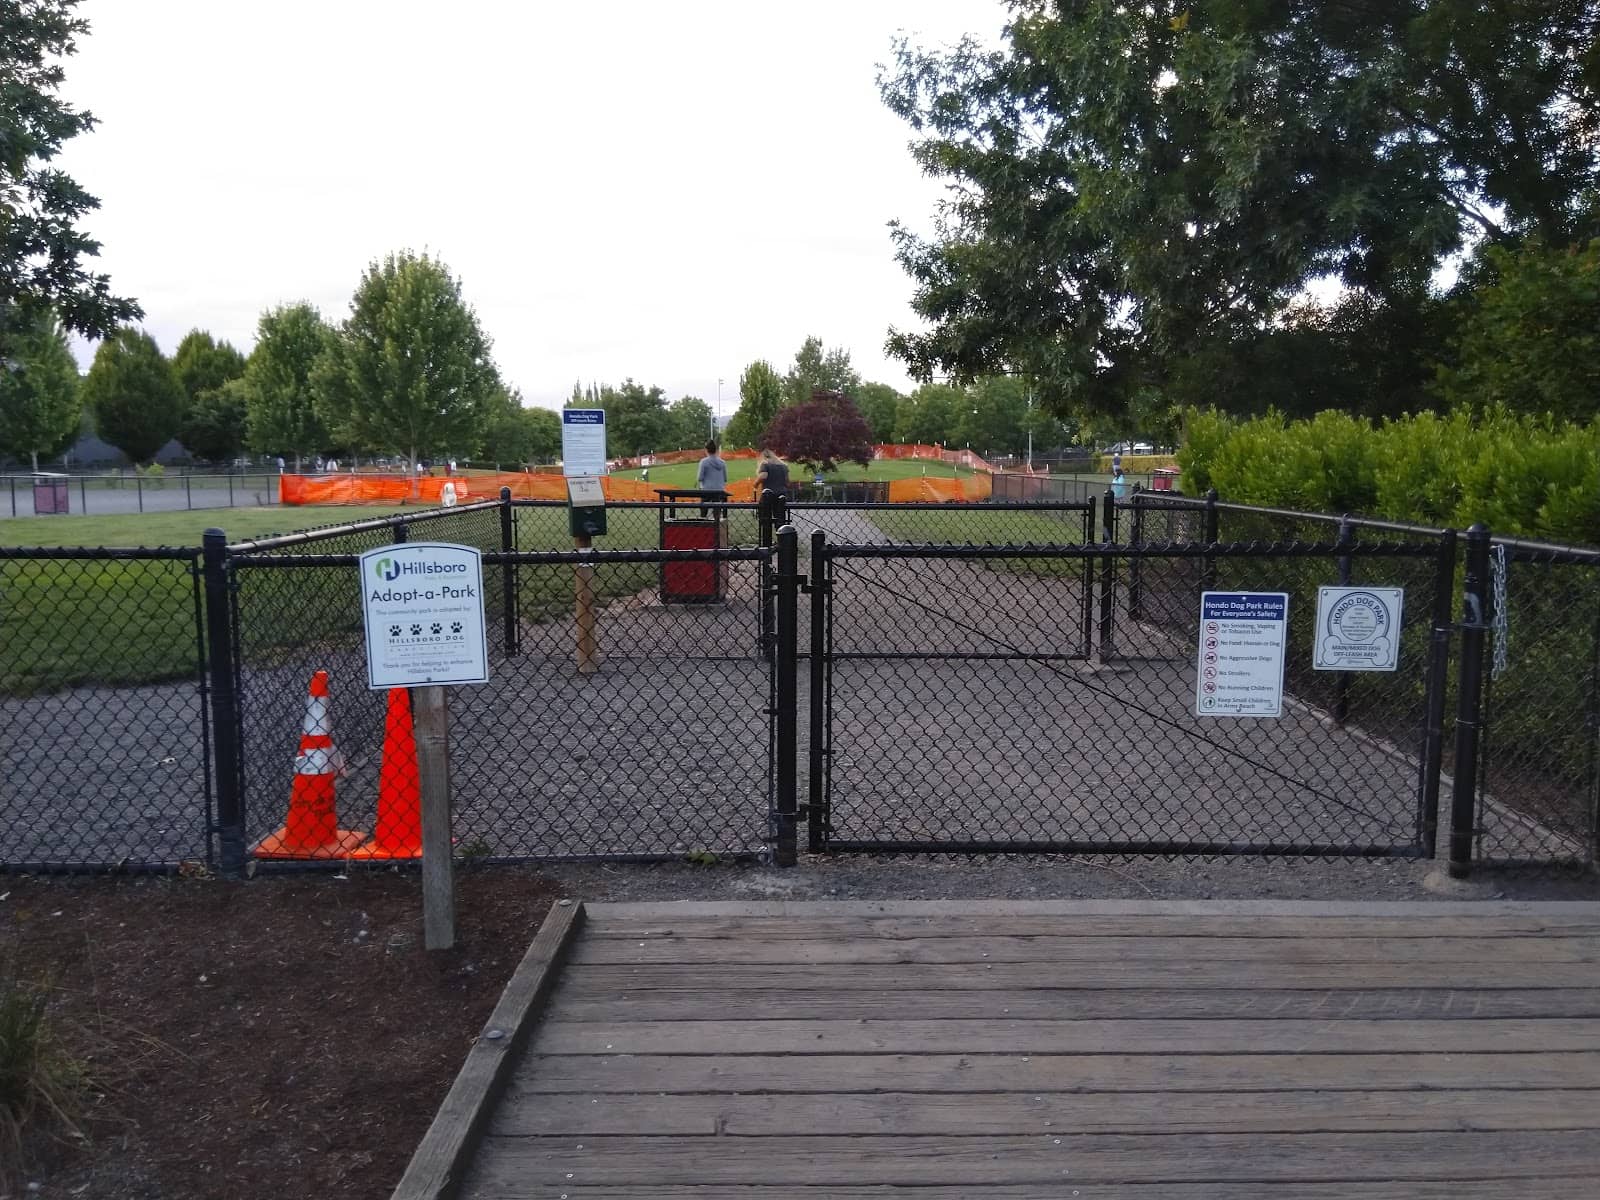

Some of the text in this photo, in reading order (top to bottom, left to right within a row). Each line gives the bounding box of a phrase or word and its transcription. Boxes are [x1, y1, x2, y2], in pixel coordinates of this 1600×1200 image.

[402, 561, 467, 575] Hillsboro
[370, 584, 476, 604] Adopt-a-Park
[1230, 602, 1245, 610] Dog
[1263, 602, 1284, 610] Rules
[1333, 597, 1384, 625] HONDO DOG PARK
[1222, 610, 1256, 618] Everyone's
[1257, 610, 1278, 618] Safety
[389, 636, 441, 644] HILLSBORO
